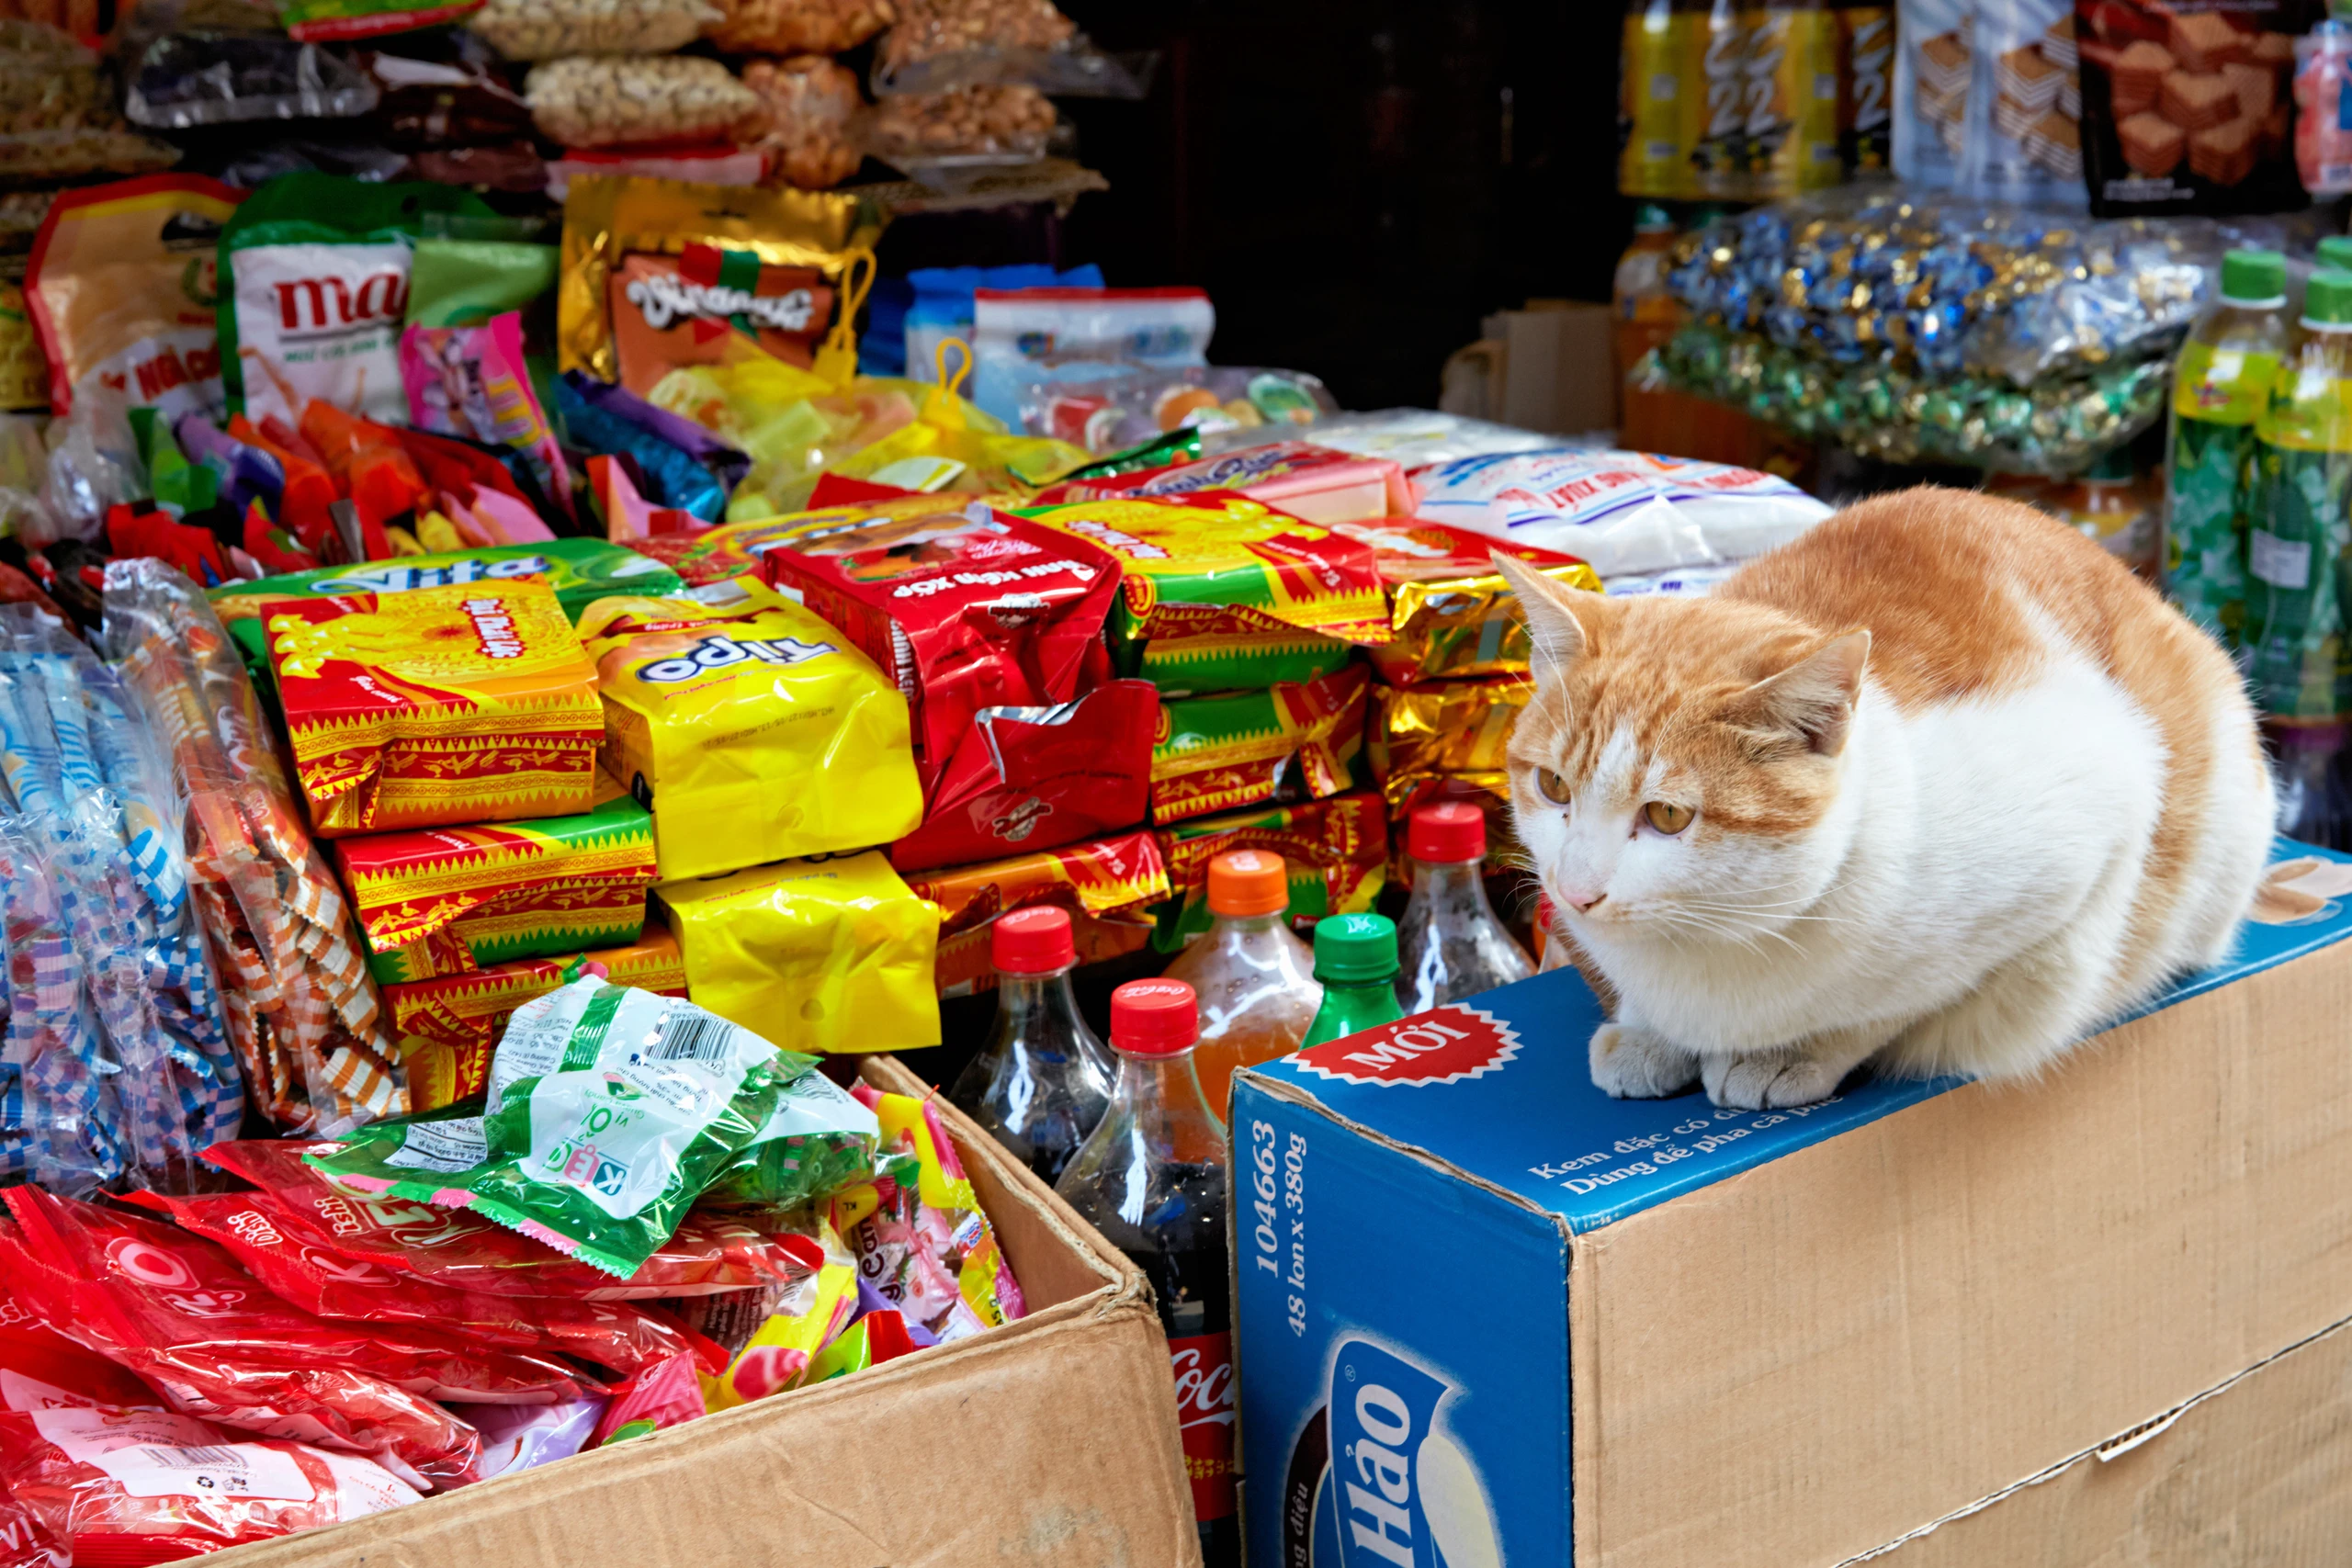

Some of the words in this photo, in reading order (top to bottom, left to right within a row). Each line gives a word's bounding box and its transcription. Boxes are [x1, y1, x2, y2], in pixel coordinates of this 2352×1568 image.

[635, 635, 842, 683] Tipo
[1341, 1021, 1471, 1072] MỚI
[1284, 1132, 1307, 1215] 380g
[1528, 1150, 1612, 1180] Kem
[1613, 1132, 1671, 1156] đặc
[1672, 1117, 1711, 1135] có
[1559, 1160, 1659, 1196] Dùng
[1653, 1144, 1695, 1167] để
[1692, 1126, 1754, 1155] pha
[1751, 1111, 1791, 1130] cà
[313, 1195, 370, 1236] ishi
[1251, 1120, 1279, 1280] 104663
[227, 1210, 284, 1247] Oishi
[1291, 1218, 1305, 1240] x
[1287, 1242, 1306, 1291] lon
[1287, 1293, 1306, 1337] 48
[1288, 1482, 1310, 1538] diệu
